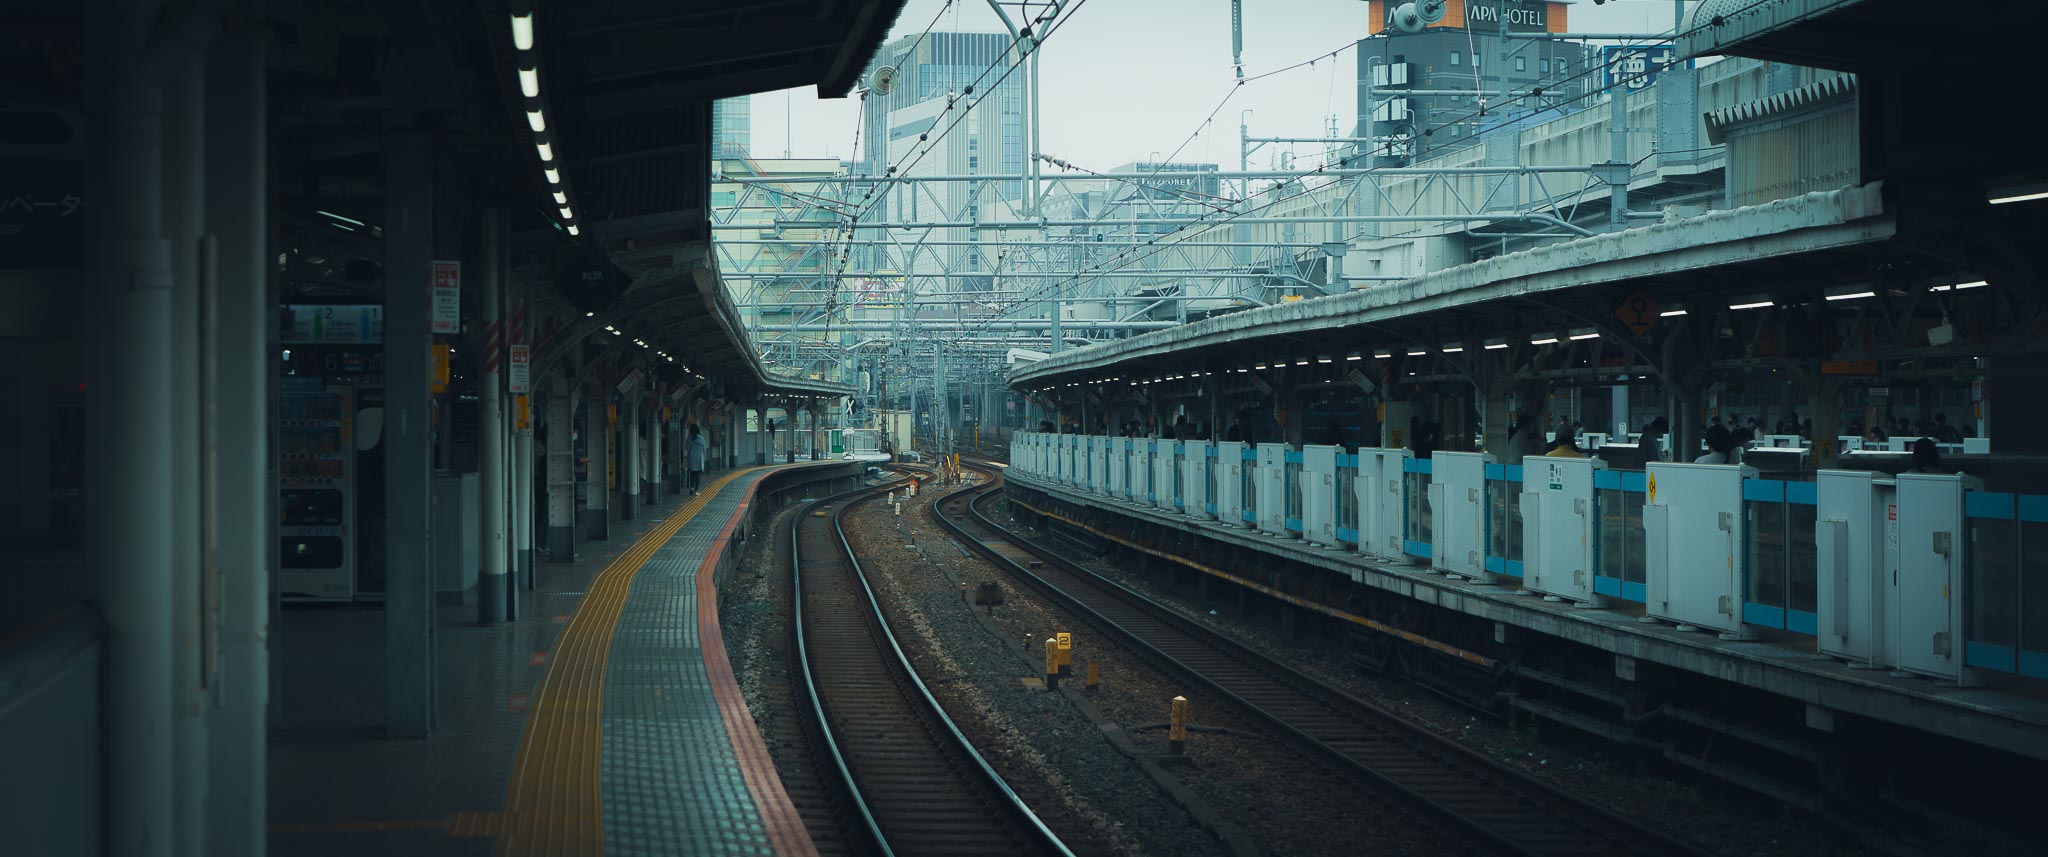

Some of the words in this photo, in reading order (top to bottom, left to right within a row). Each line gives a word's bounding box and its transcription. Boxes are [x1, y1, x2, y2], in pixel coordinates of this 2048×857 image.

[1470, 5, 1498, 22] APA
[0, 192, 87, 216] ベータ
[325, 308, 332, 319] 2
[1059, 635, 1069, 646] 2
